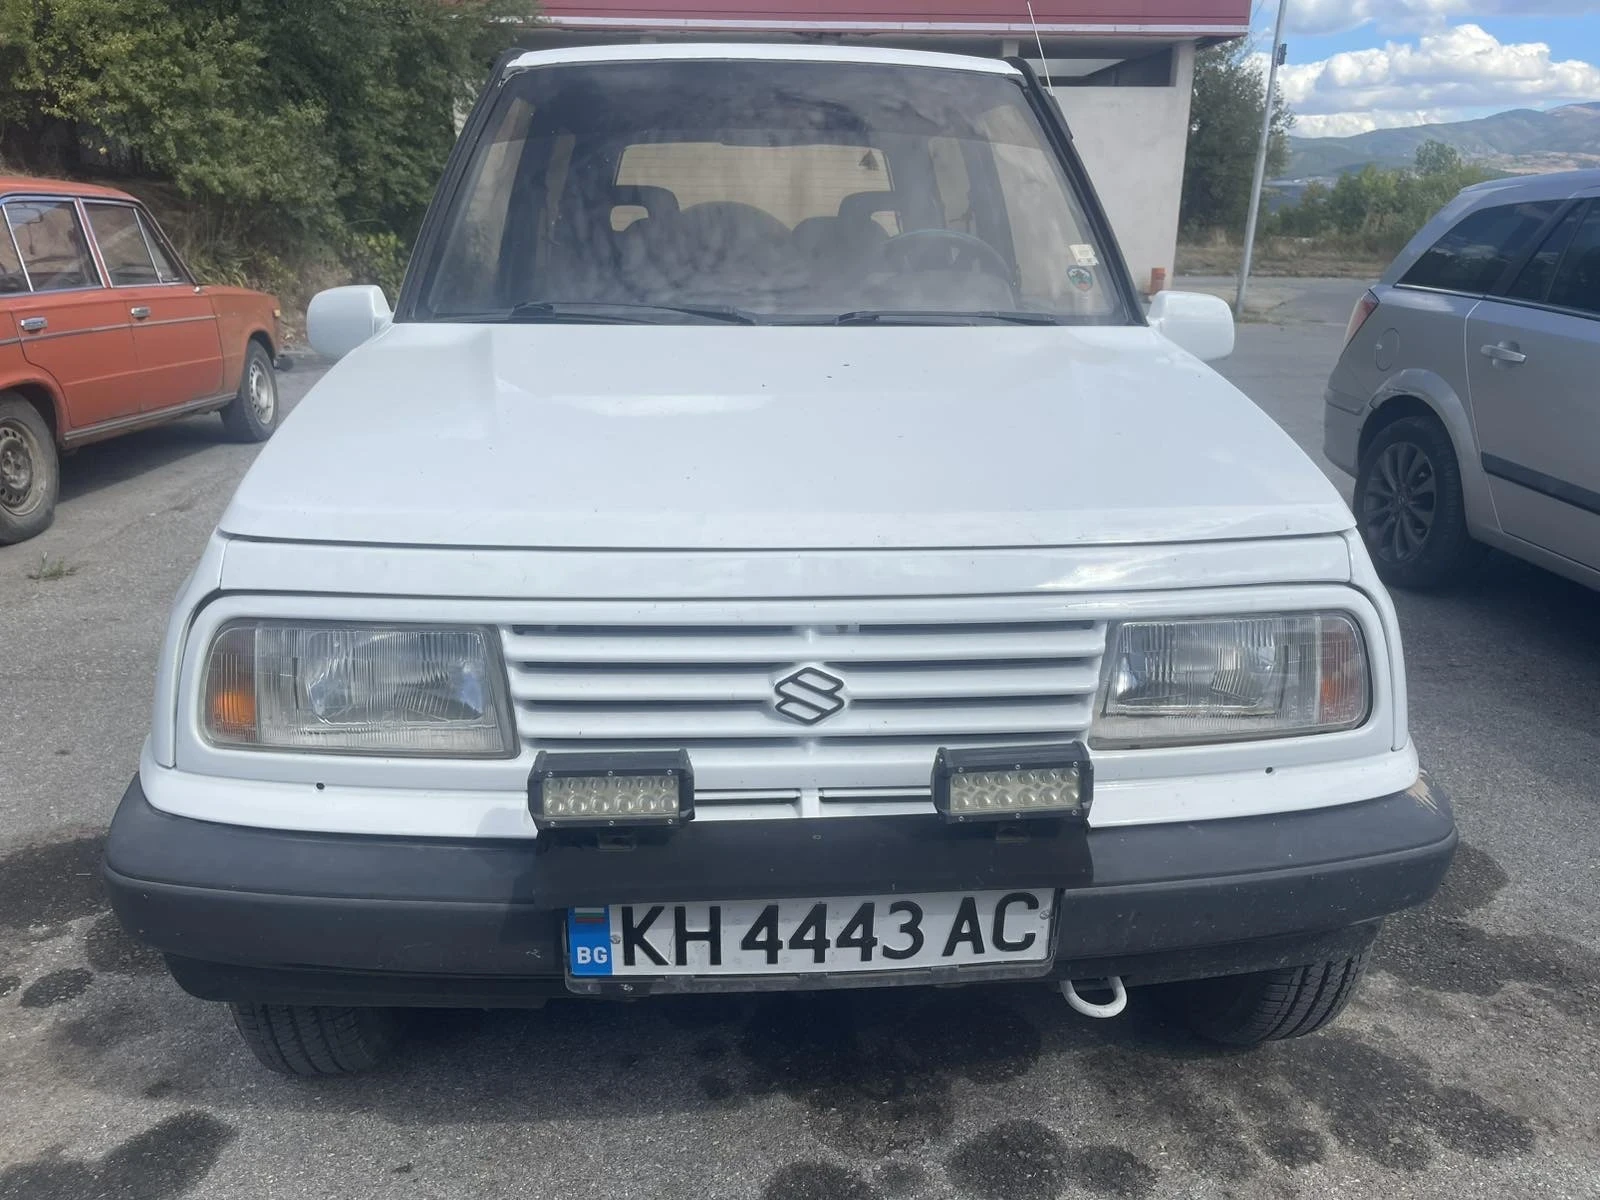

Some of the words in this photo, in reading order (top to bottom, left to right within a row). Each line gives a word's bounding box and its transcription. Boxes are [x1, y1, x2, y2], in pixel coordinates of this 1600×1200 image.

[621, 905, 722, 966] KH
[740, 900, 925, 965] 4443
[941, 891, 1040, 957] AC
[576, 946, 608, 965] BG
